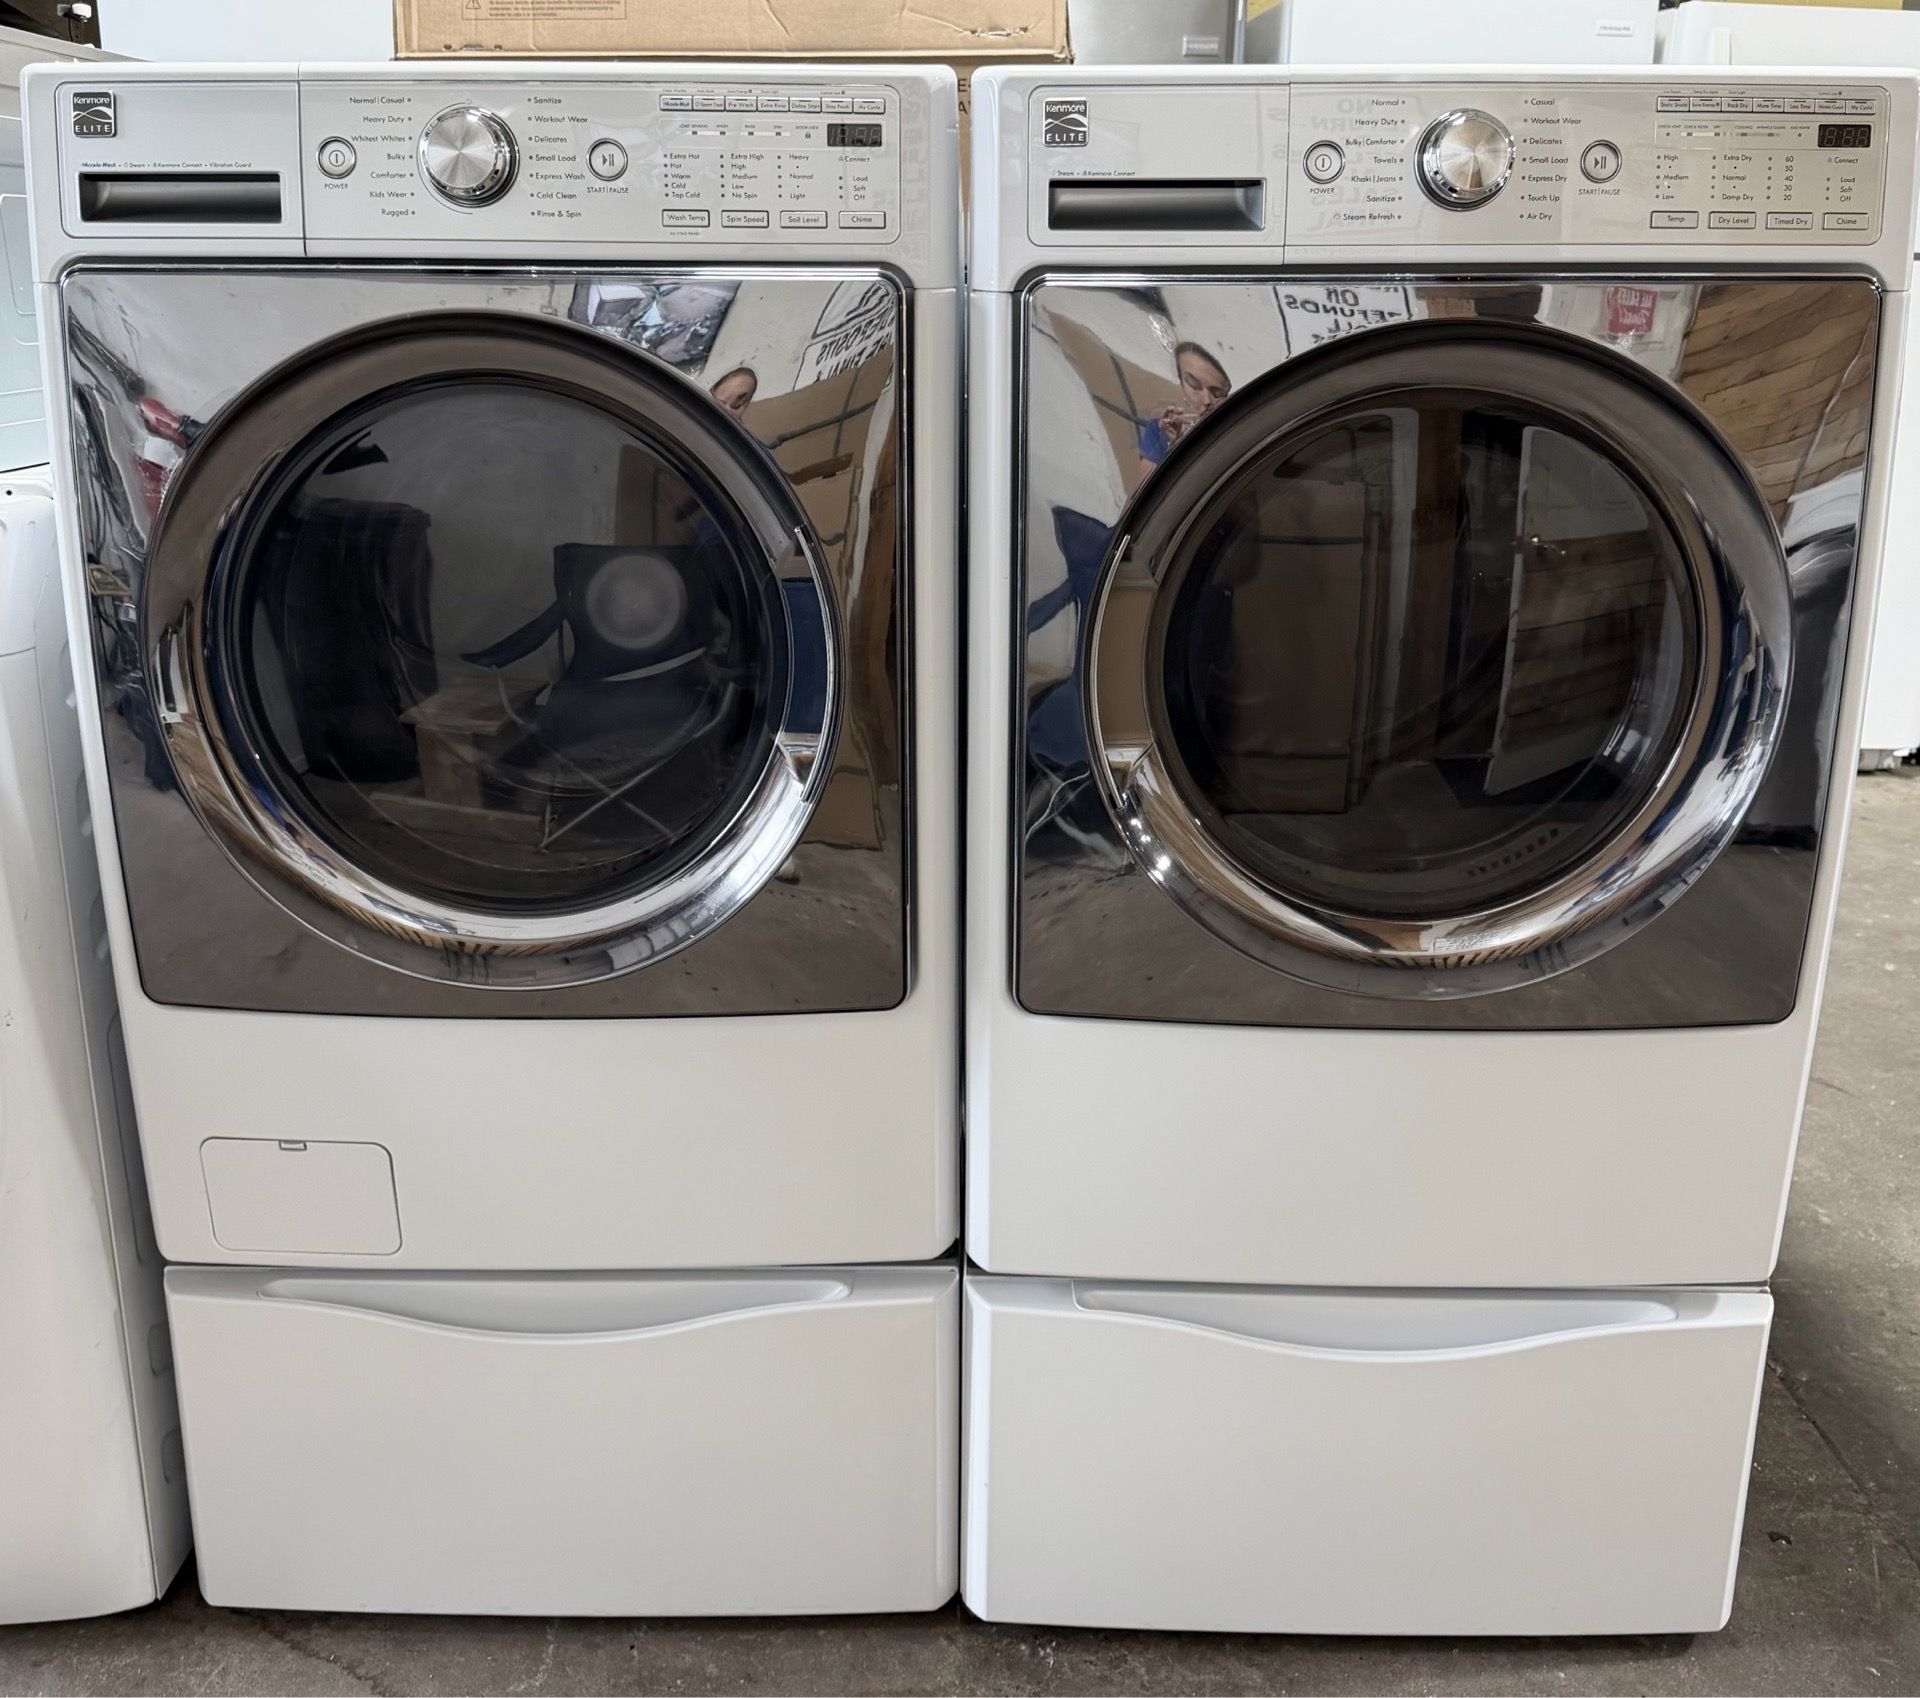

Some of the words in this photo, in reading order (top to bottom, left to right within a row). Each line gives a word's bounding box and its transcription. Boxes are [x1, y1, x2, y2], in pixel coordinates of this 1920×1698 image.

[74, 96, 110, 104] Kenmore
[1046, 104, 1085, 112] Kenmore
[1046, 133, 1084, 142] ELITE
[1528, 175, 1553, 183] Express
[1555, 175, 1567, 183] Dry
[381, 209, 408, 217] Rugged
[566, 210, 581, 218] Spin
[726, 215, 742, 223] Spin
[1667, 215, 1685, 223] Temp
